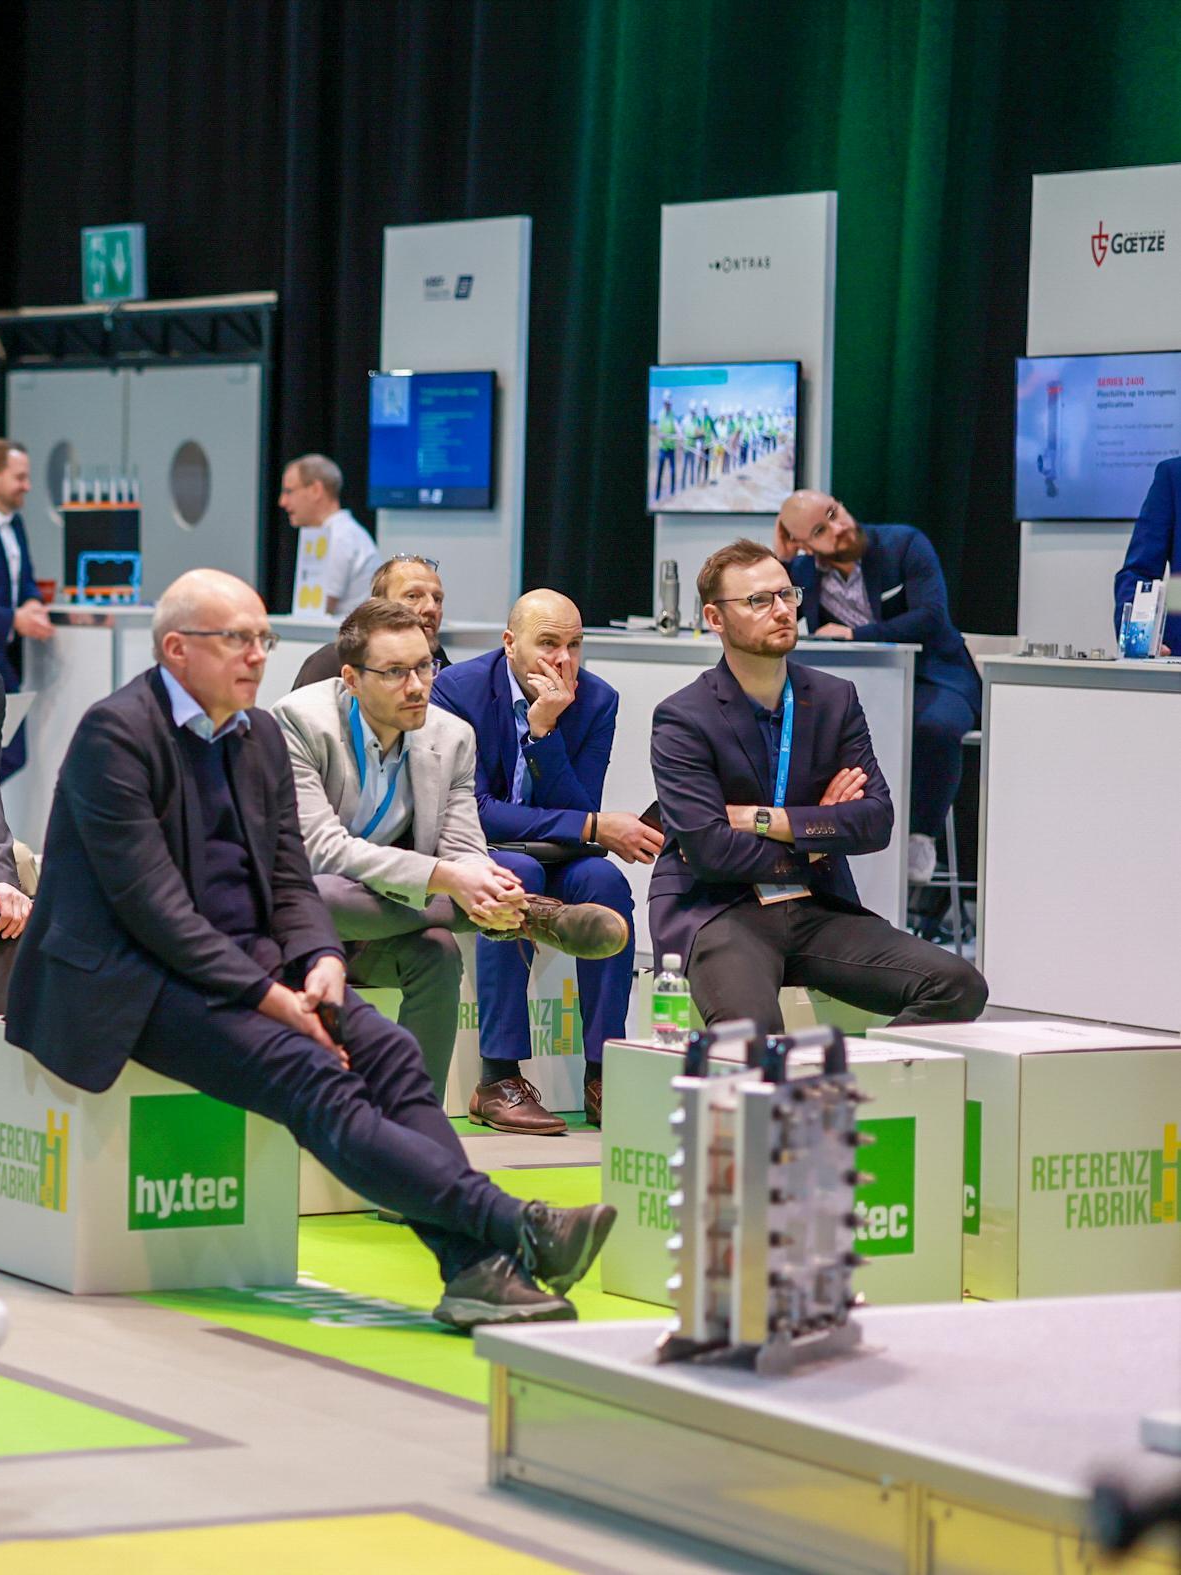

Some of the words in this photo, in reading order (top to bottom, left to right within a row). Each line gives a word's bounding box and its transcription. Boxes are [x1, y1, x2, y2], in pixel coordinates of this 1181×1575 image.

[1031, 1150, 1150, 1192] REFERENZ
[135, 1173, 238, 1219] hy.tec
[1066, 1190, 1149, 1230] FABRIK
